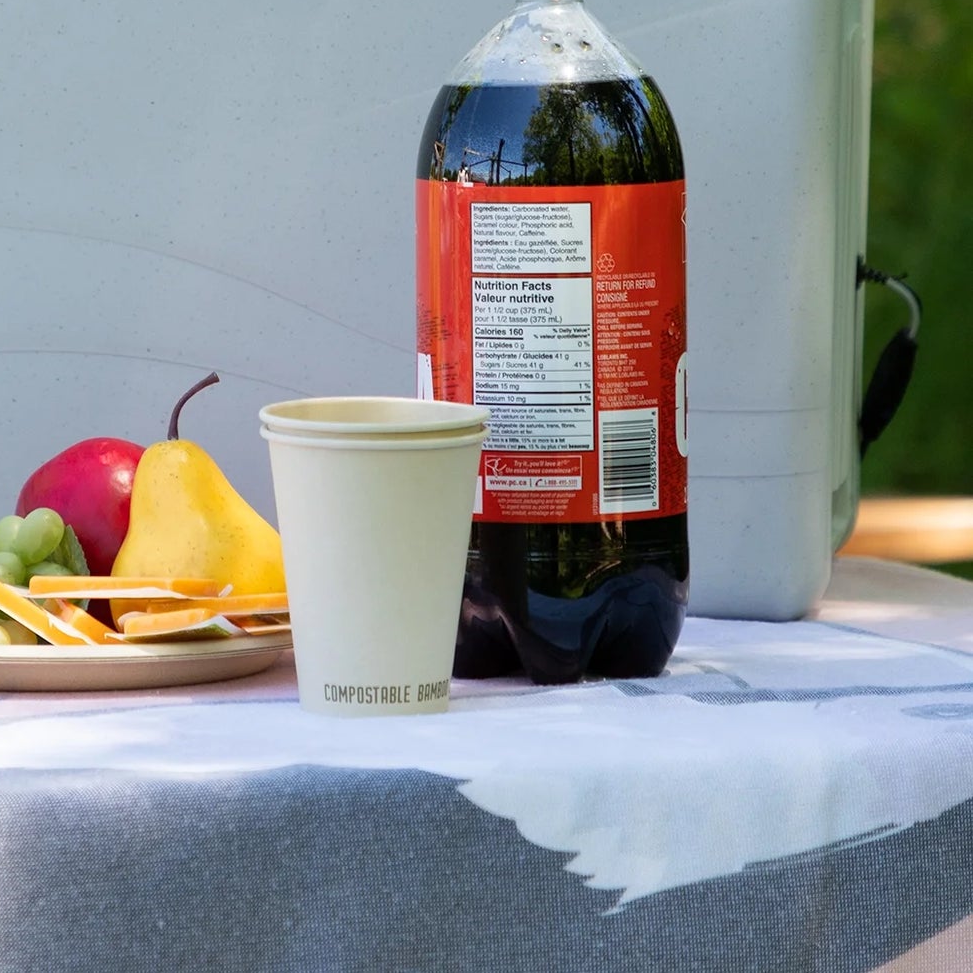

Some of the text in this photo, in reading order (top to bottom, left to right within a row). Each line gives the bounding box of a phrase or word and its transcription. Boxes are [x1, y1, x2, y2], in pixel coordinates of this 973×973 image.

[475, 281, 552, 290] Nutrition Facts
[597, 279, 656, 291] RETURN FOR REFUND
[475, 293, 554, 303] Valeur nutritive
[530, 316, 546, 324] (375
[548, 316, 562, 324] mL)
[475, 352, 517, 360] Carbohydrate
[324, 683, 411, 704] COMPOSTABLE
